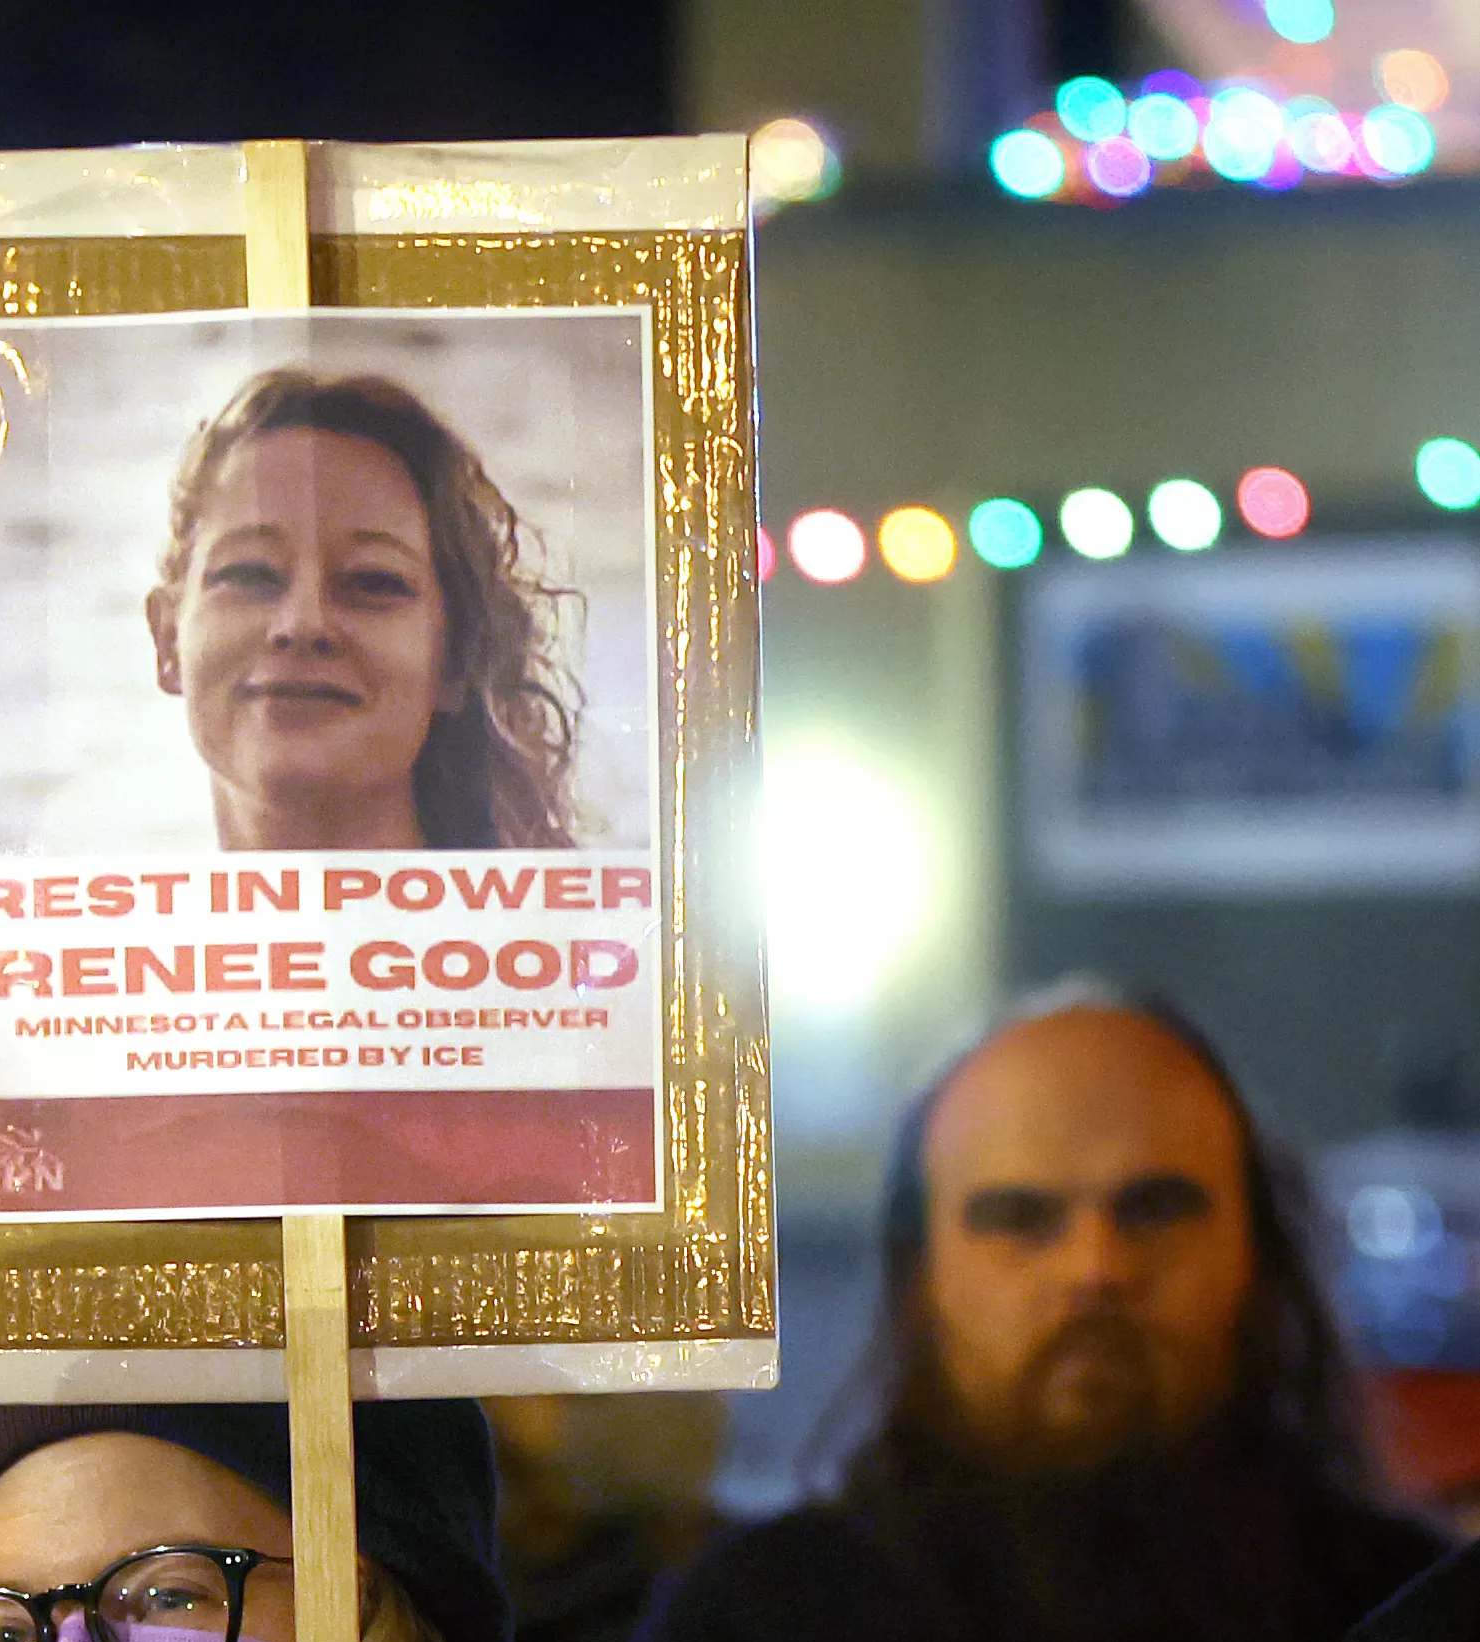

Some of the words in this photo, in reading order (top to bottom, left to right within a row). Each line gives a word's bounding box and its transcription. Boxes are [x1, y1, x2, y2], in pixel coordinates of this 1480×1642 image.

[210, 869, 300, 914] IN
[323, 867, 652, 911] POWER
[349, 939, 639, 992] GOOD
[14, 1011, 249, 1038] MINNESOTA
[259, 1008, 389, 1034] LEGAL
[396, 1007, 609, 1031] OBSERVER
[126, 1046, 349, 1072] MURDERED
[358, 1045, 413, 1067] BY
[422, 1045, 485, 1067] ICE
